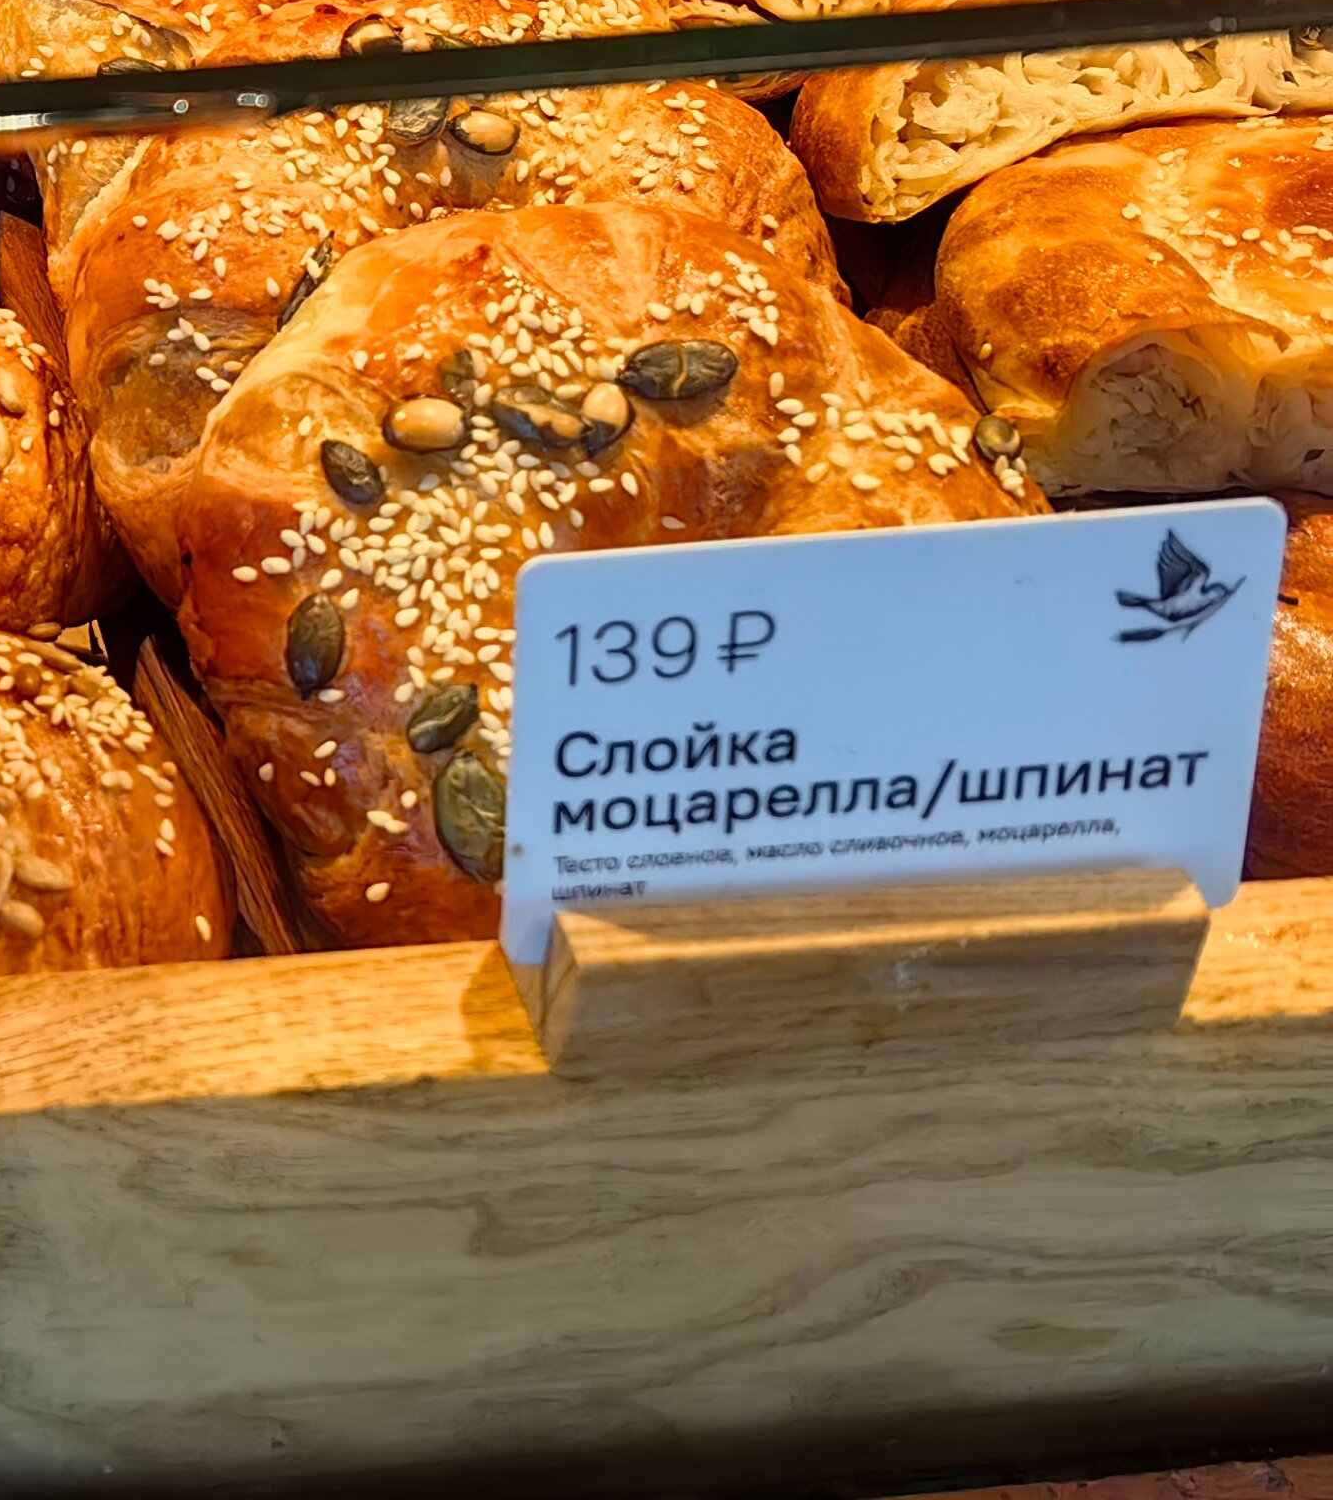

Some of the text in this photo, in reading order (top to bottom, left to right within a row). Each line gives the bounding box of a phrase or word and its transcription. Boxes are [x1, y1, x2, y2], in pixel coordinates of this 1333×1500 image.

[555, 610, 777, 687] 139 ₽
[555, 721, 799, 778] Слойка
[552, 750, 1210, 835] моцарелла/шпинат
[553, 854, 621, 874] Тесто
[626, 848, 739, 868] слоеное,
[746, 841, 824, 861] масло
[977, 816, 1121, 844] моцарелла,
[551, 880, 648, 901] шпинат
